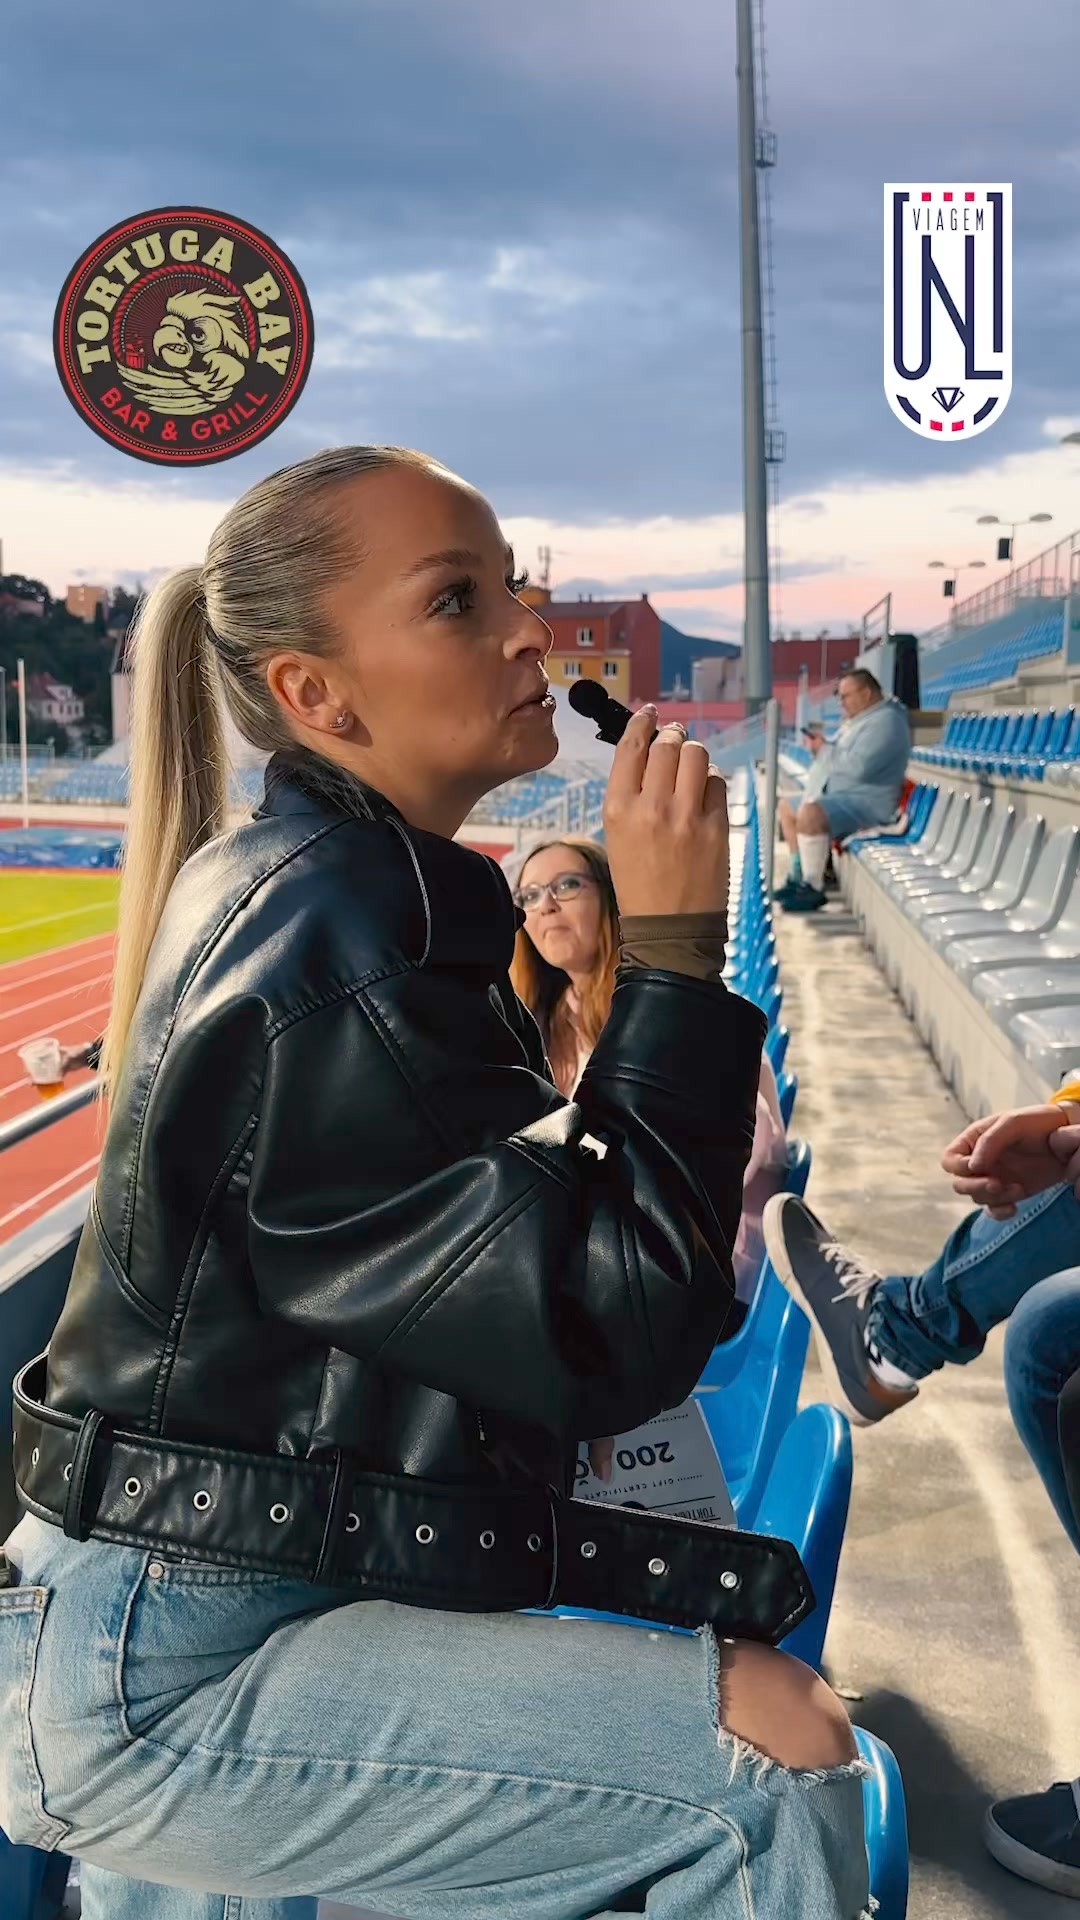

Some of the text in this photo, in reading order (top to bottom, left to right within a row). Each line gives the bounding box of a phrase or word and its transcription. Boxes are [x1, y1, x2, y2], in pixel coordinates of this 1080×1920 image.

[616, 1441, 675, 1470] 200
[583, 1483, 647, 1500] CERTIFICATE
[652, 1478, 674, 1488] GIFT
